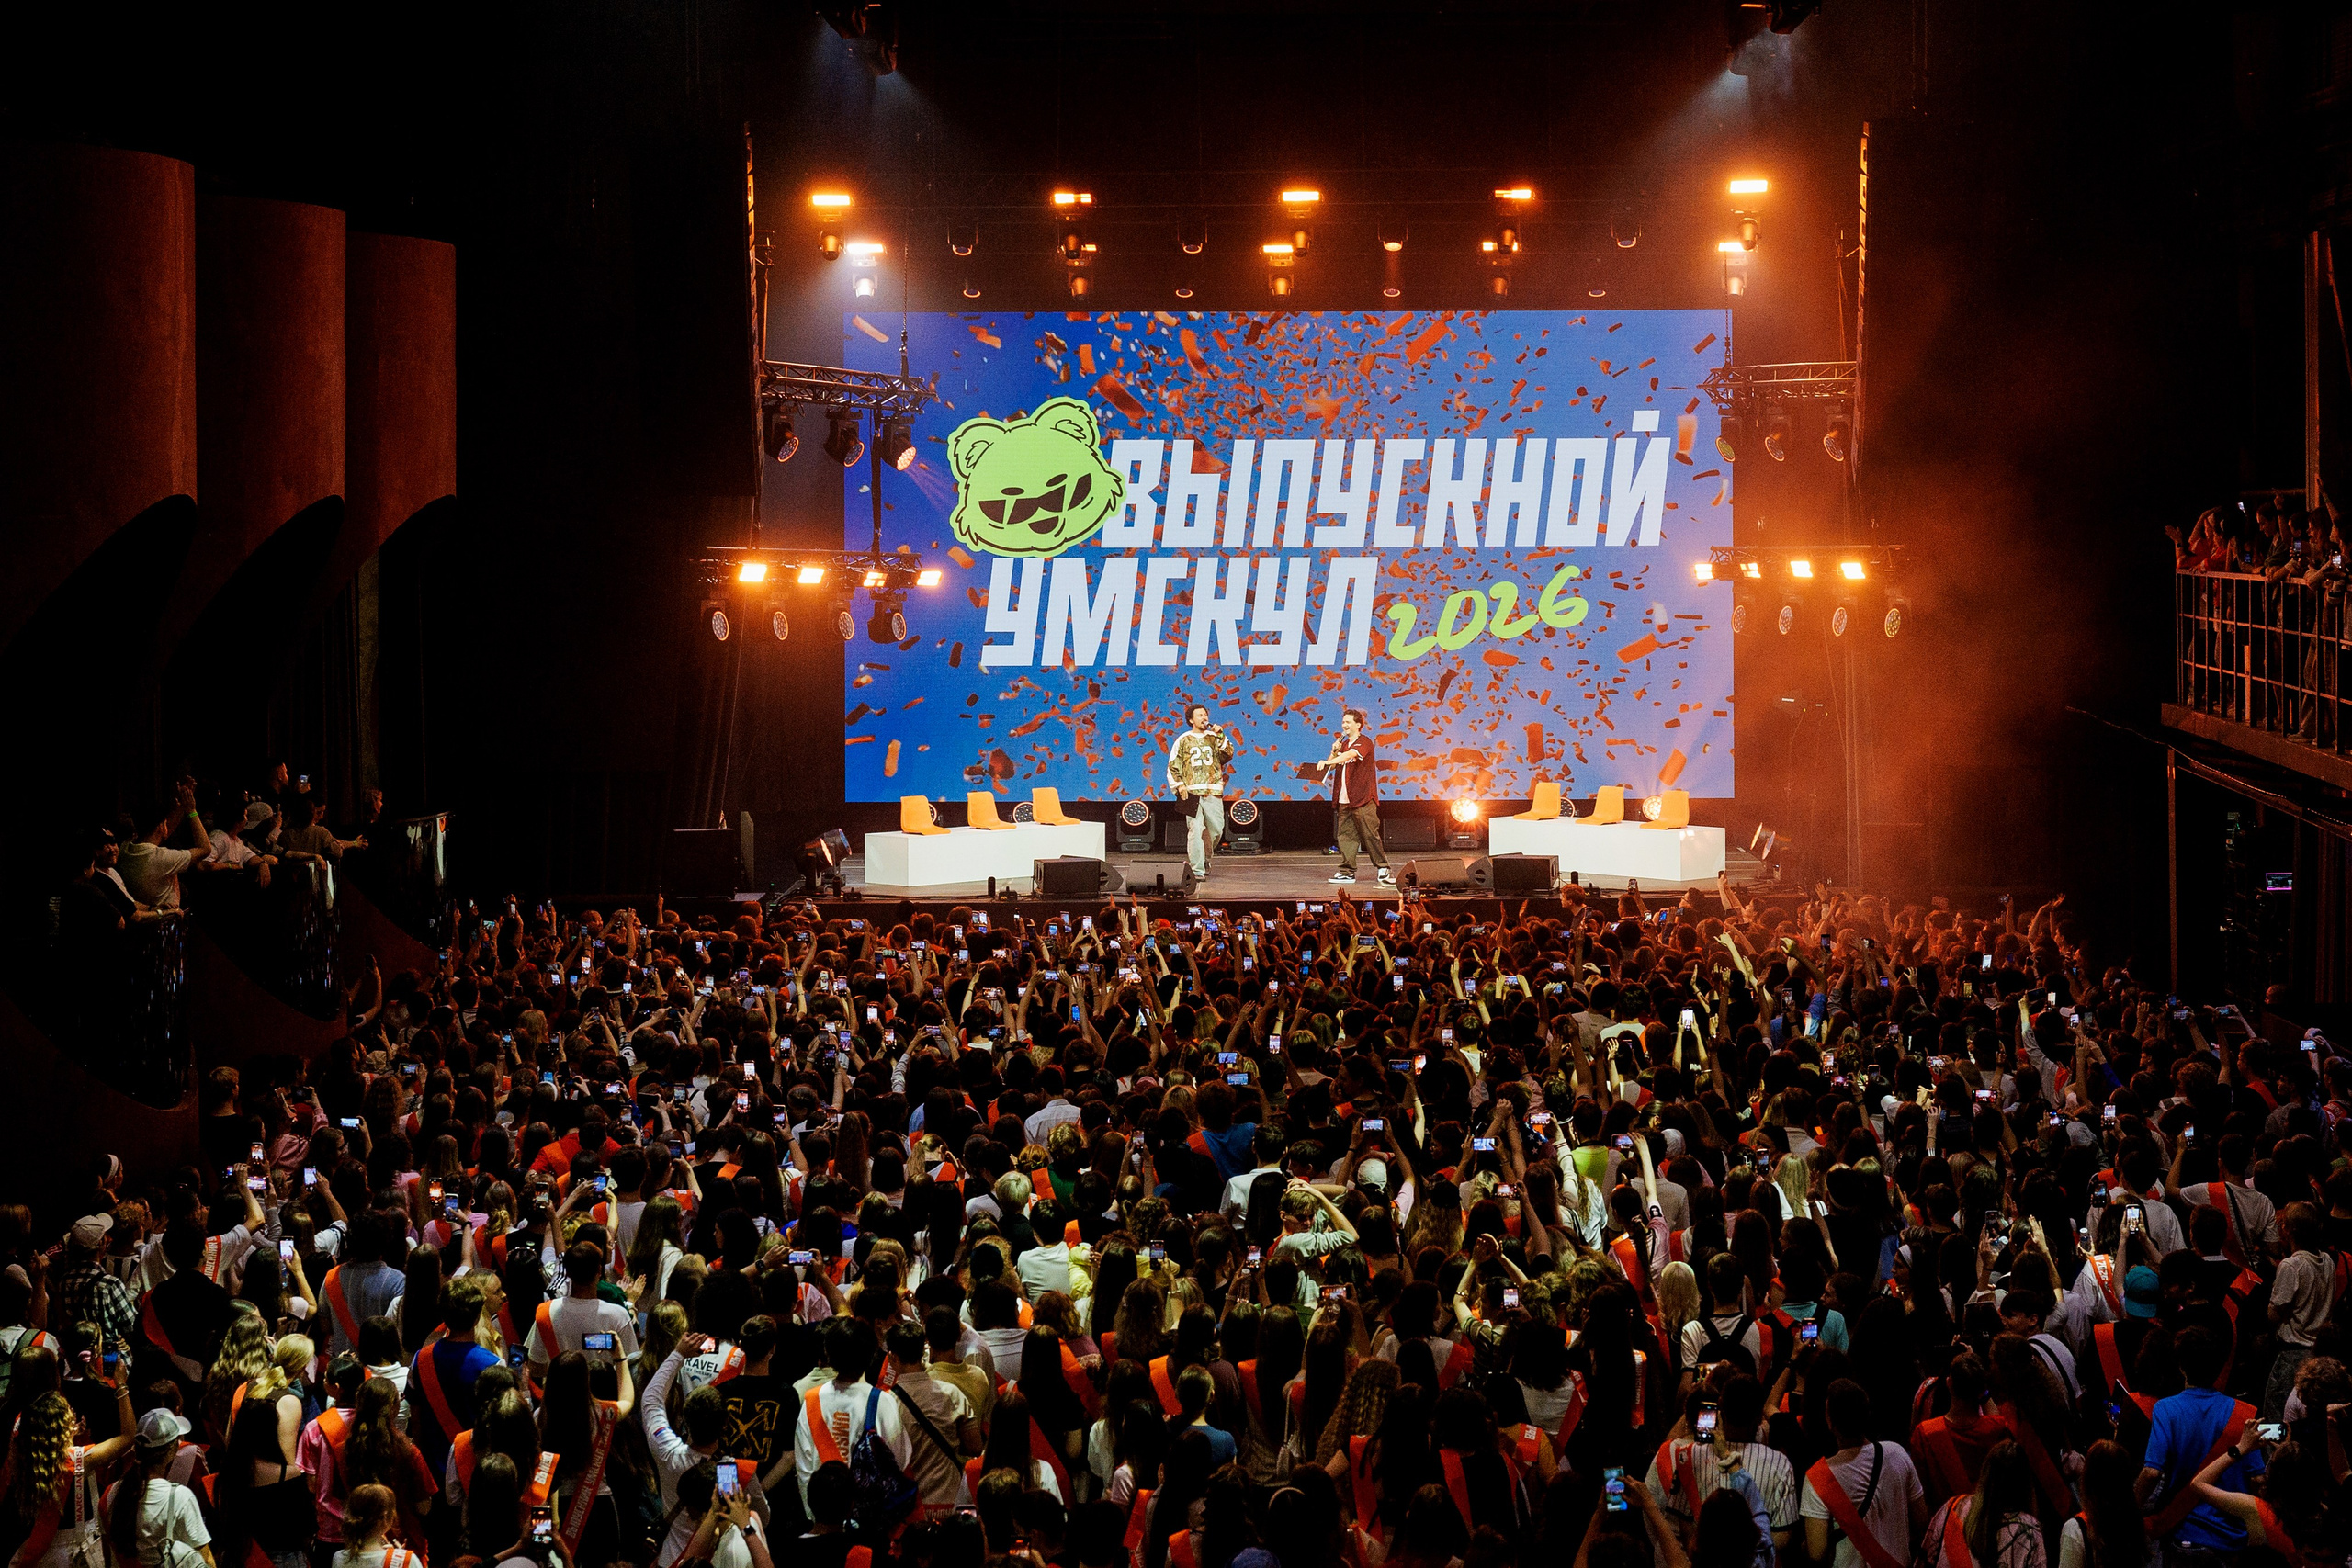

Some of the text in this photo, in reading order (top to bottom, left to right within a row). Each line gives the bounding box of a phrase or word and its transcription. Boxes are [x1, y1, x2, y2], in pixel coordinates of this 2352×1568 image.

[1101, 410, 1670, 548] ВЫПУСКНОЙ
[981, 557, 1589, 666] УМСКУЛ 2026
[1190, 745, 1214, 766] 23
[685, 1357, 720, 1373] RAVEL
